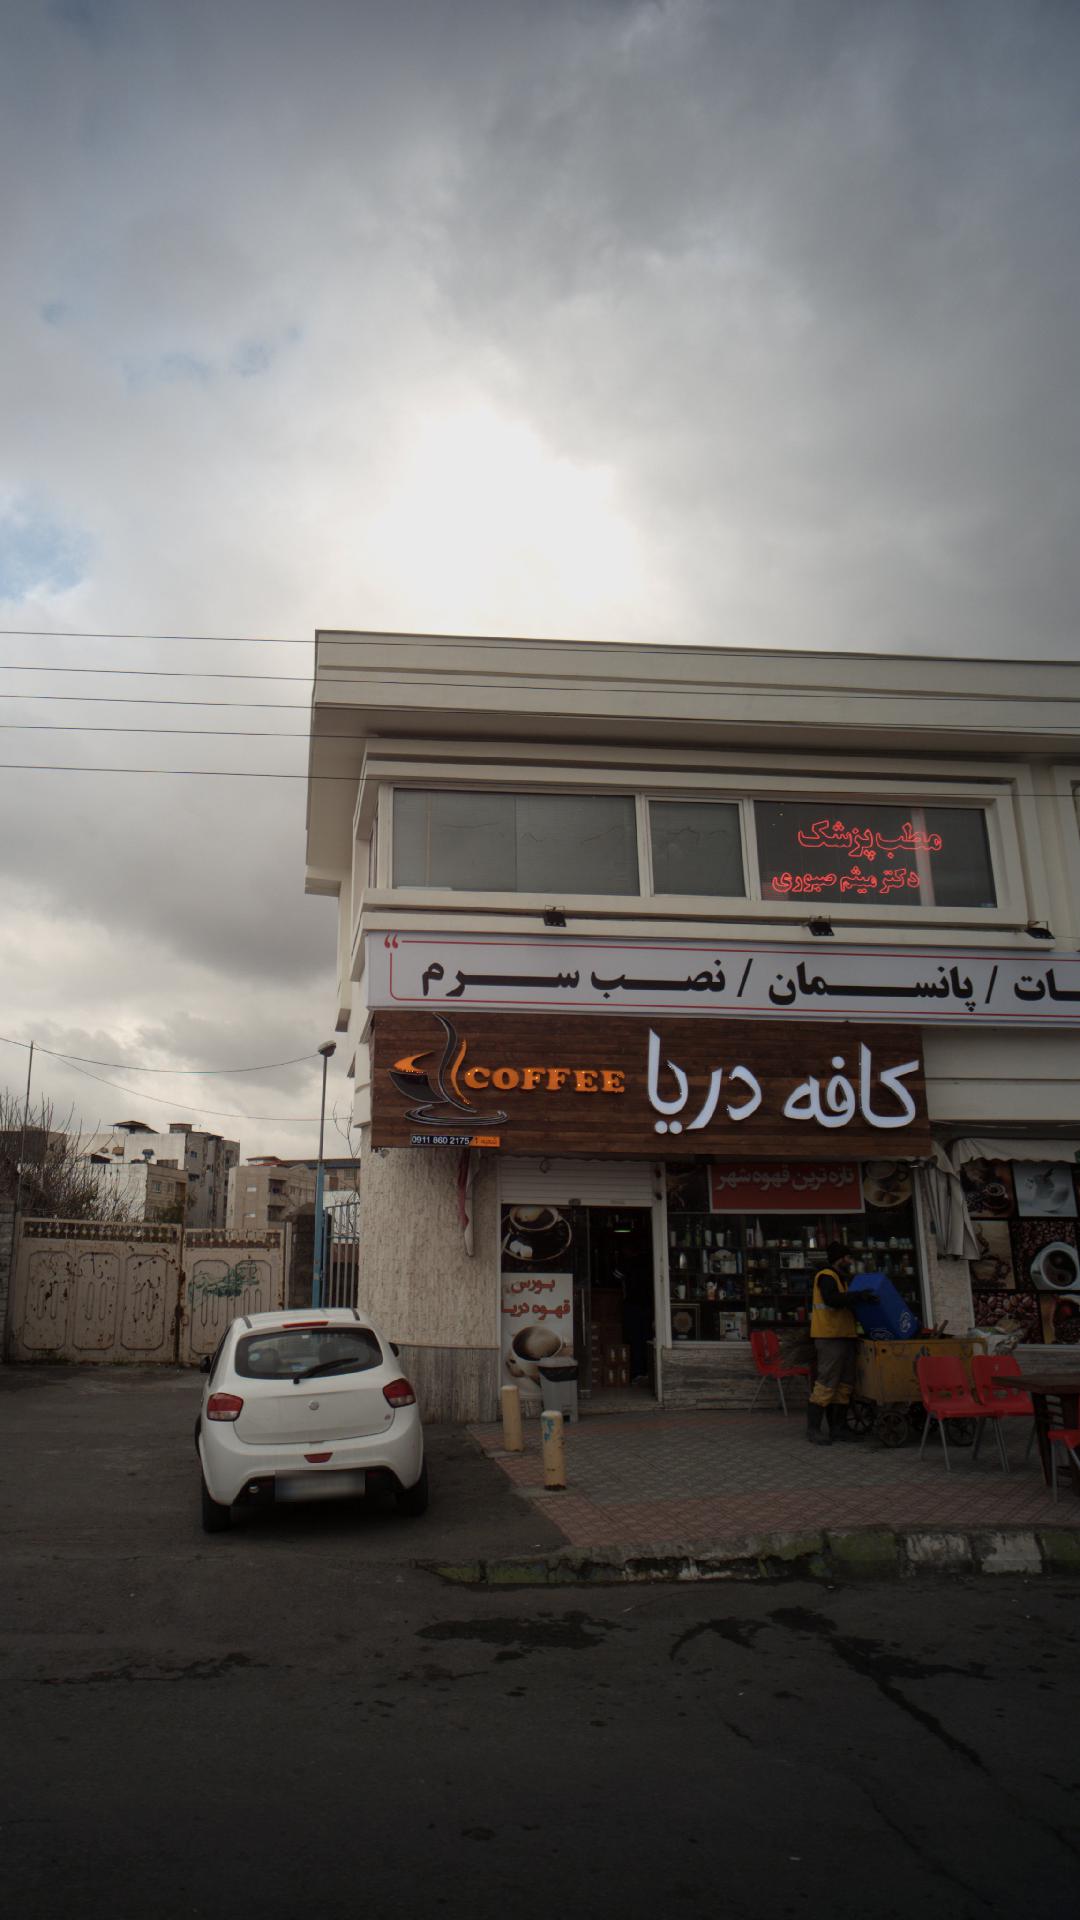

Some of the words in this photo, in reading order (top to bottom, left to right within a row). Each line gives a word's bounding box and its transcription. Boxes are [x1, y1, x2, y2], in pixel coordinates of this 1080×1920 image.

[798, 820, 876, 861] پزشک
[876, 822, 943, 859] مطب
[772, 872, 836, 893] صبوری
[840, 866, 877, 894] میثم
[880, 868, 920, 893] دکتر
[422, 962, 580, 997] سرم
[591, 958, 725, 1000] نصب
[768, 961, 976, 1012] پانسمان
[464, 1066, 625, 1093] COFFEE
[648, 1027, 762, 1134] دریا
[783, 1041, 919, 1128] کافه
[411, 1135, 430, 1145] 0911
[449, 1136, 470, 1145] 2175
[715, 1167, 751, 1190] شهر
[752, 1164, 790, 1190] قهوه
[511, 1279, 556, 1294] بورس
[501, 1299, 529, 1317] دریا
[532, 1299, 571, 1320] قهوه
